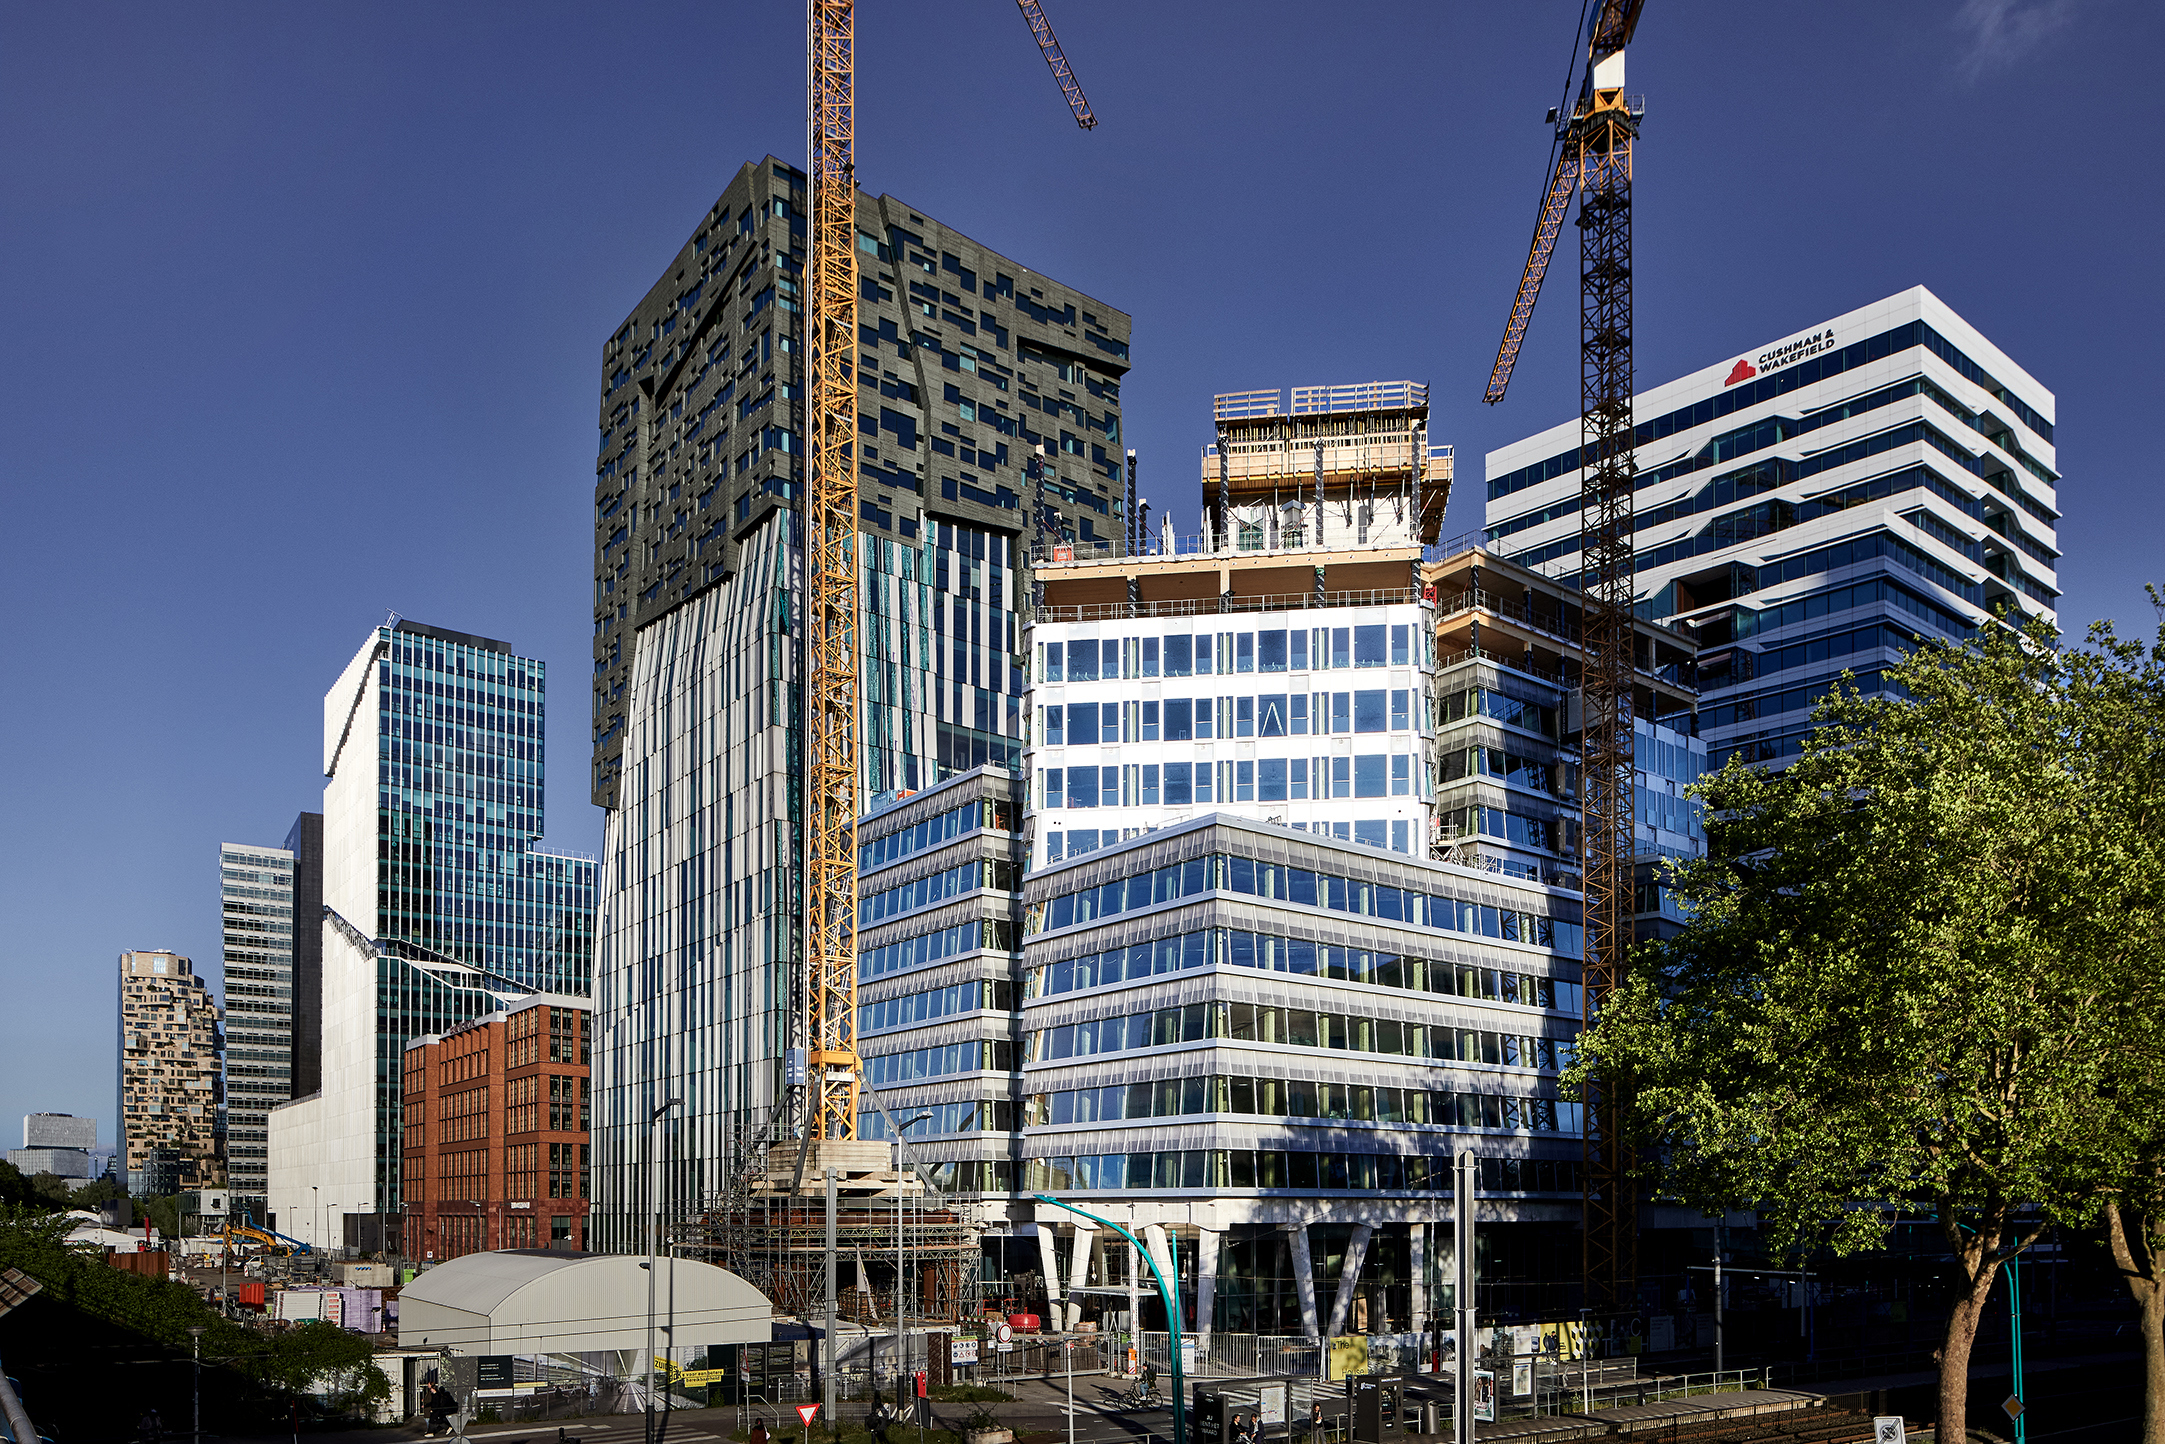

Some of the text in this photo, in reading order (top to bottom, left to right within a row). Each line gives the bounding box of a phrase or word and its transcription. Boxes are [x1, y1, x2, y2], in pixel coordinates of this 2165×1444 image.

[1759, 329, 1834, 364] CUSHMAN &
[1759, 339, 1835, 373] WAKEFIELD
